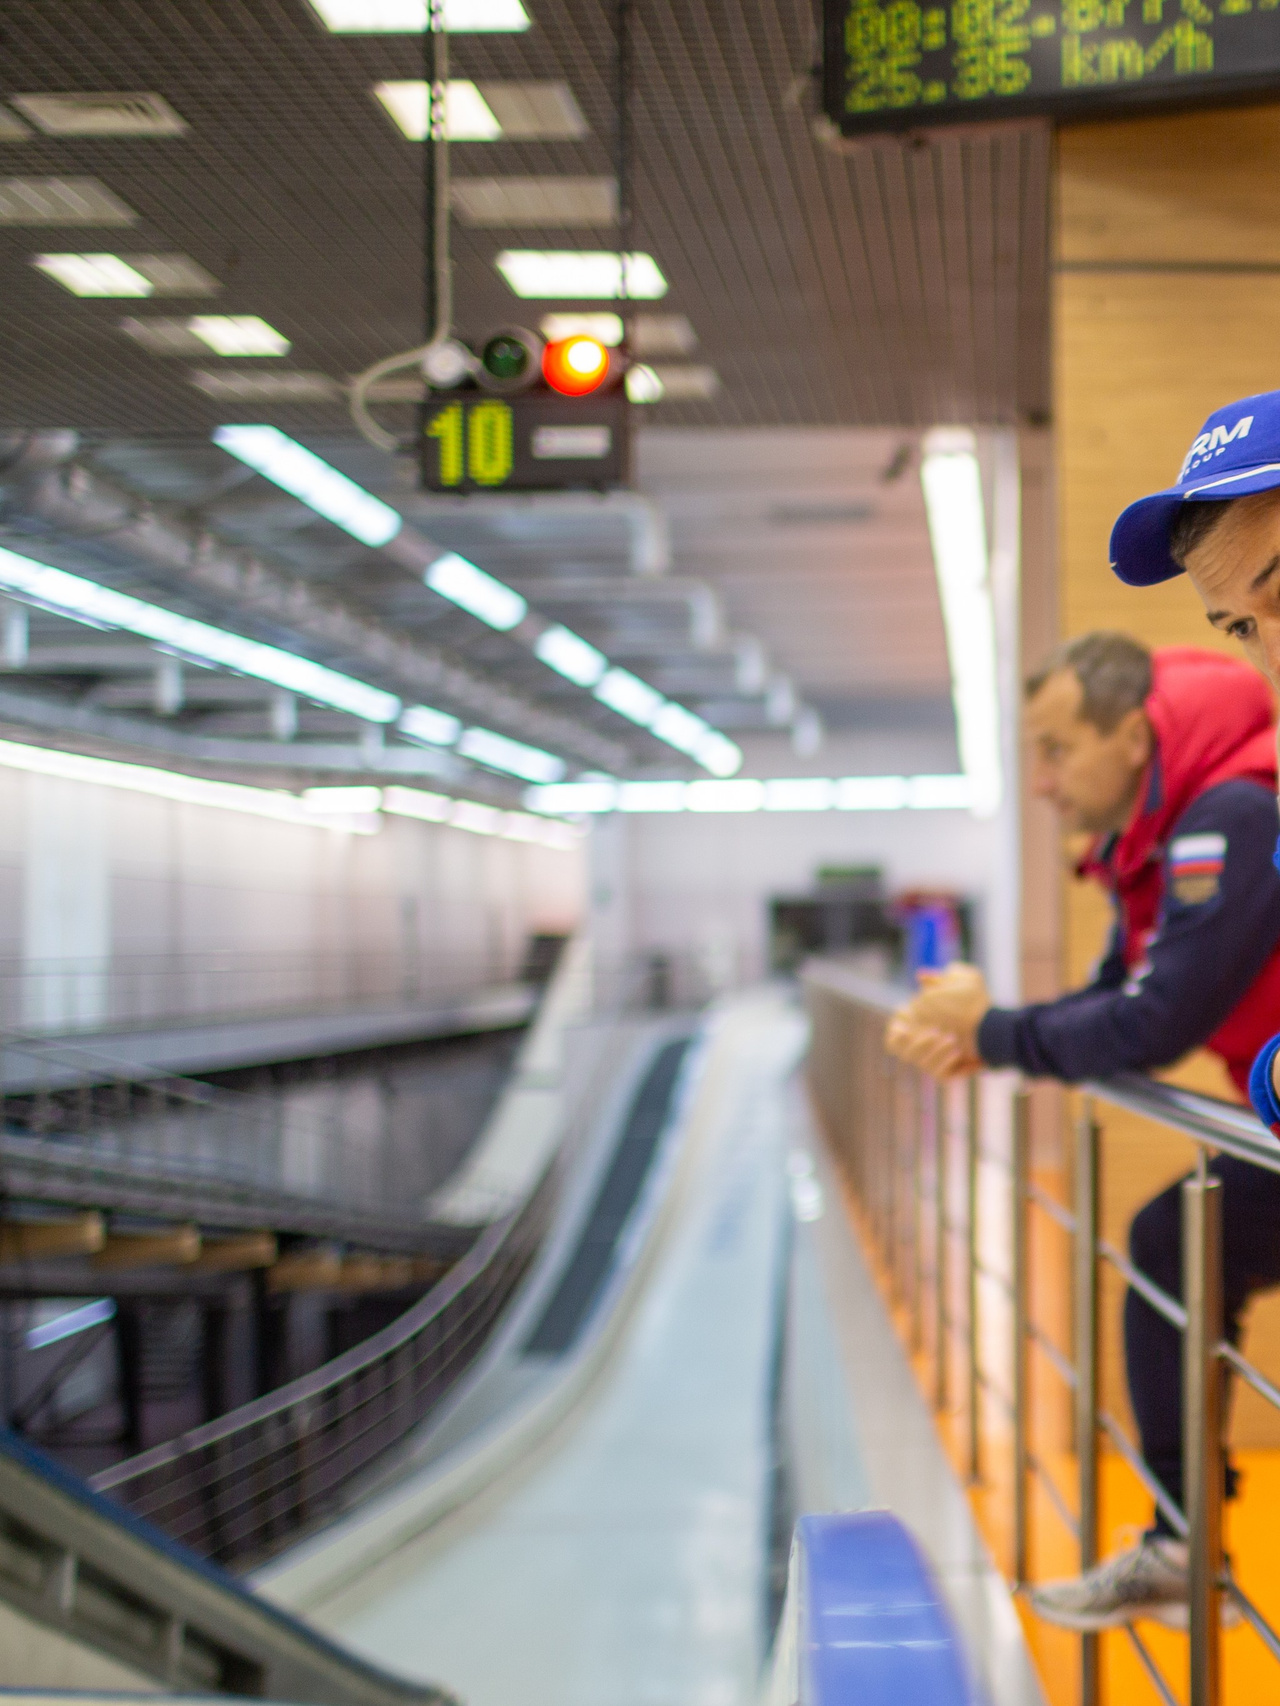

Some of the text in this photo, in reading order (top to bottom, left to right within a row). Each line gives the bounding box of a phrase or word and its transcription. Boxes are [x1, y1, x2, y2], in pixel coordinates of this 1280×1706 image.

[1060, 18, 1214, 89] km/h
[424, 400, 514, 487] 10
[1178, 415, 1254, 485] RM
